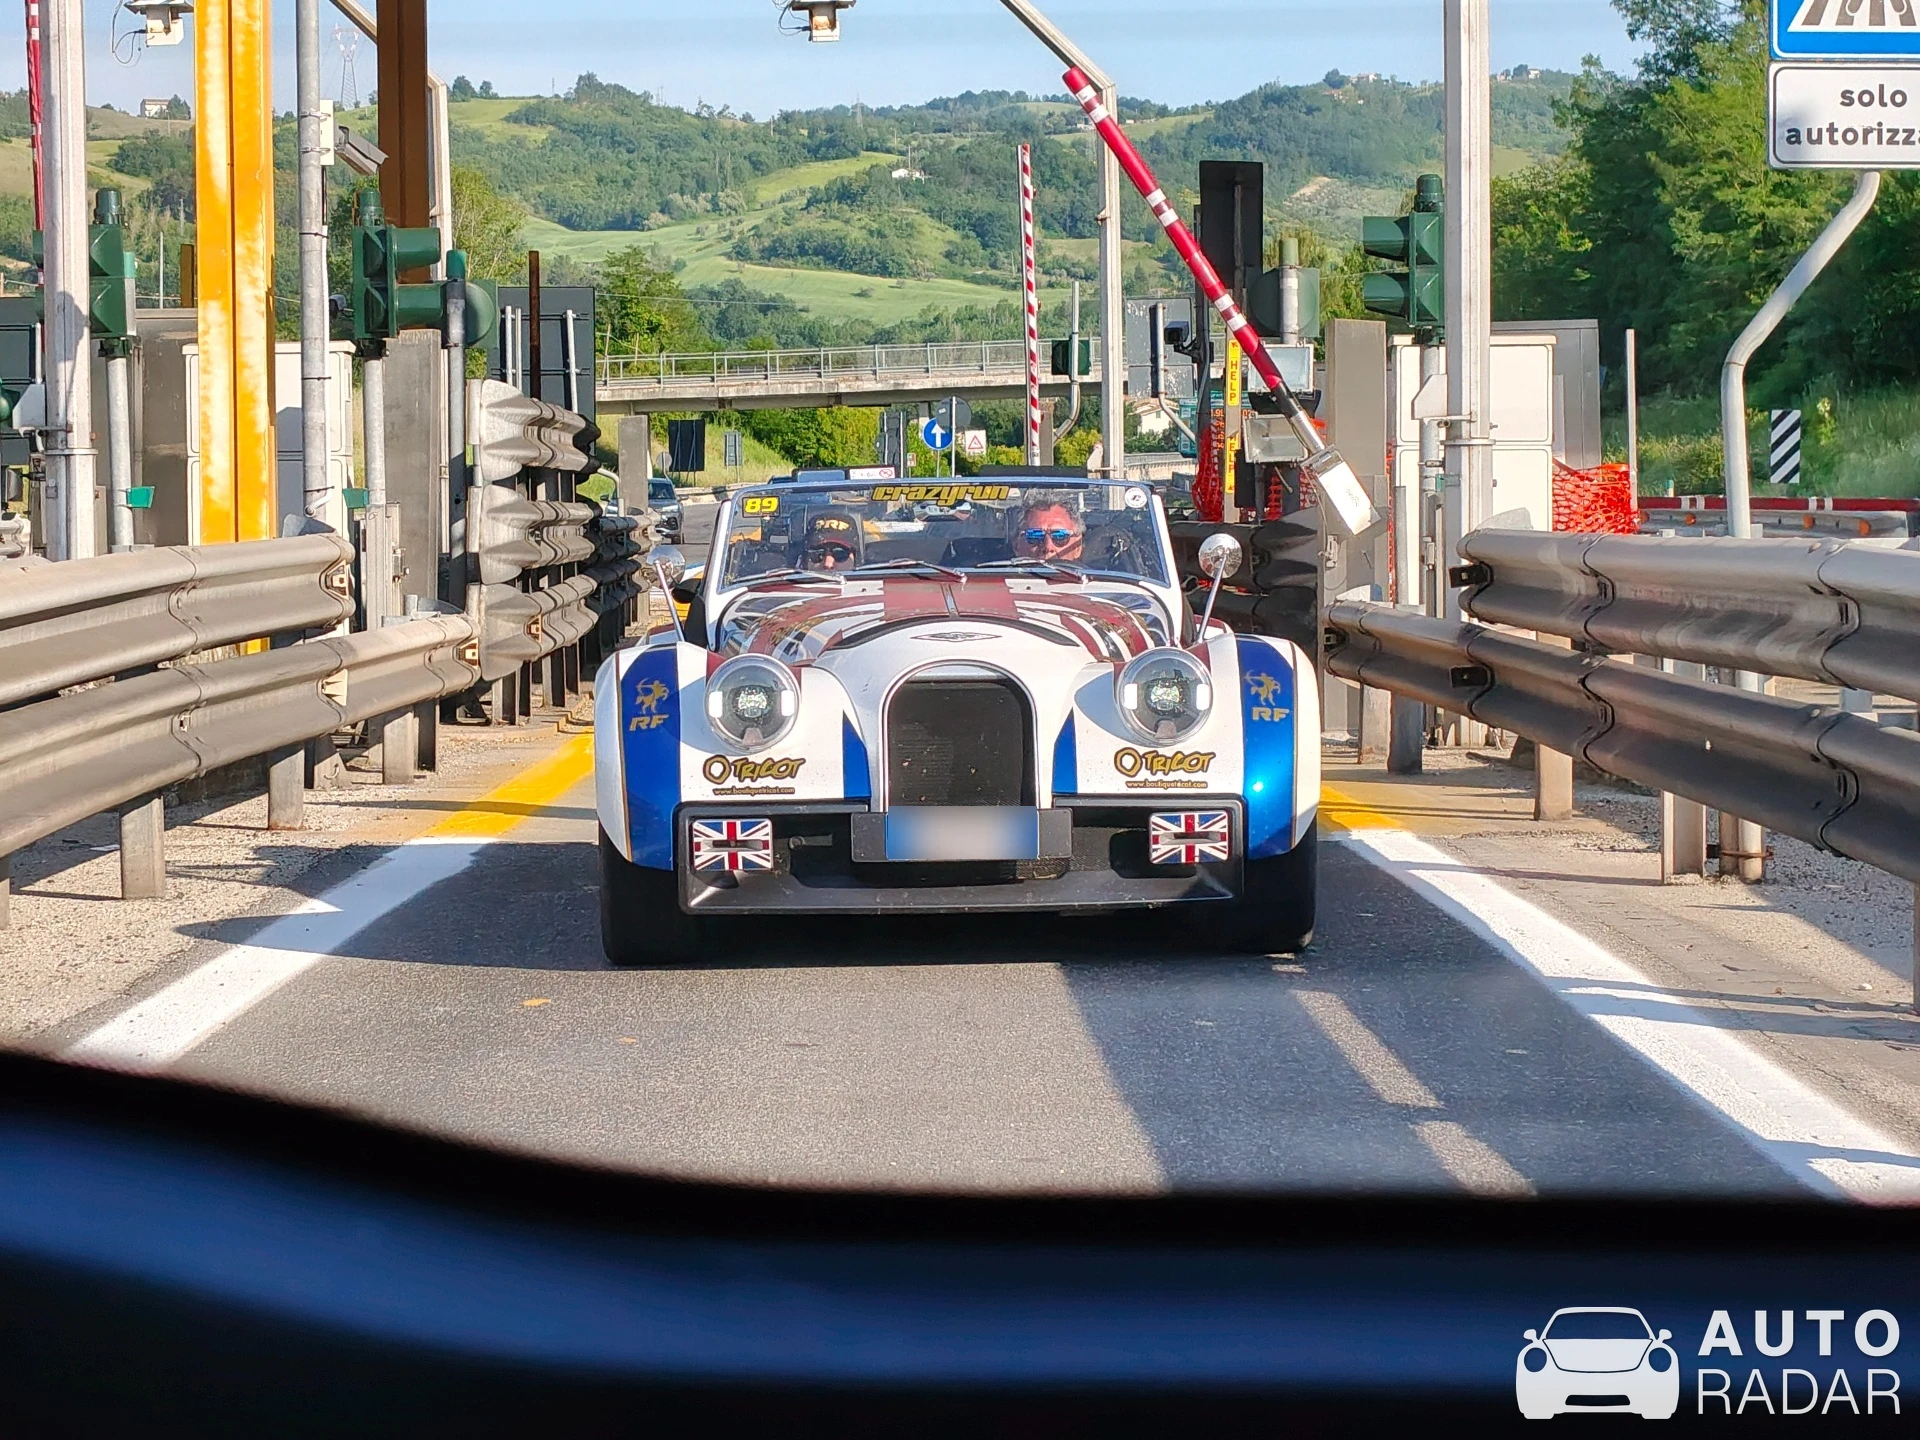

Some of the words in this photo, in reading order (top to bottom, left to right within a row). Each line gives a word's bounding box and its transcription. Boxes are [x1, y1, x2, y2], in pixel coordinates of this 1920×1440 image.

[1839, 83, 1908, 108] solo
[1785, 121, 1920, 146] autorizz
[1230, 360, 1238, 402] HELP
[745, 497, 779, 513] 89
[872, 485, 1010, 507] crazyrun
[629, 714, 670, 732] RF
[1252, 706, 1290, 722] RF
